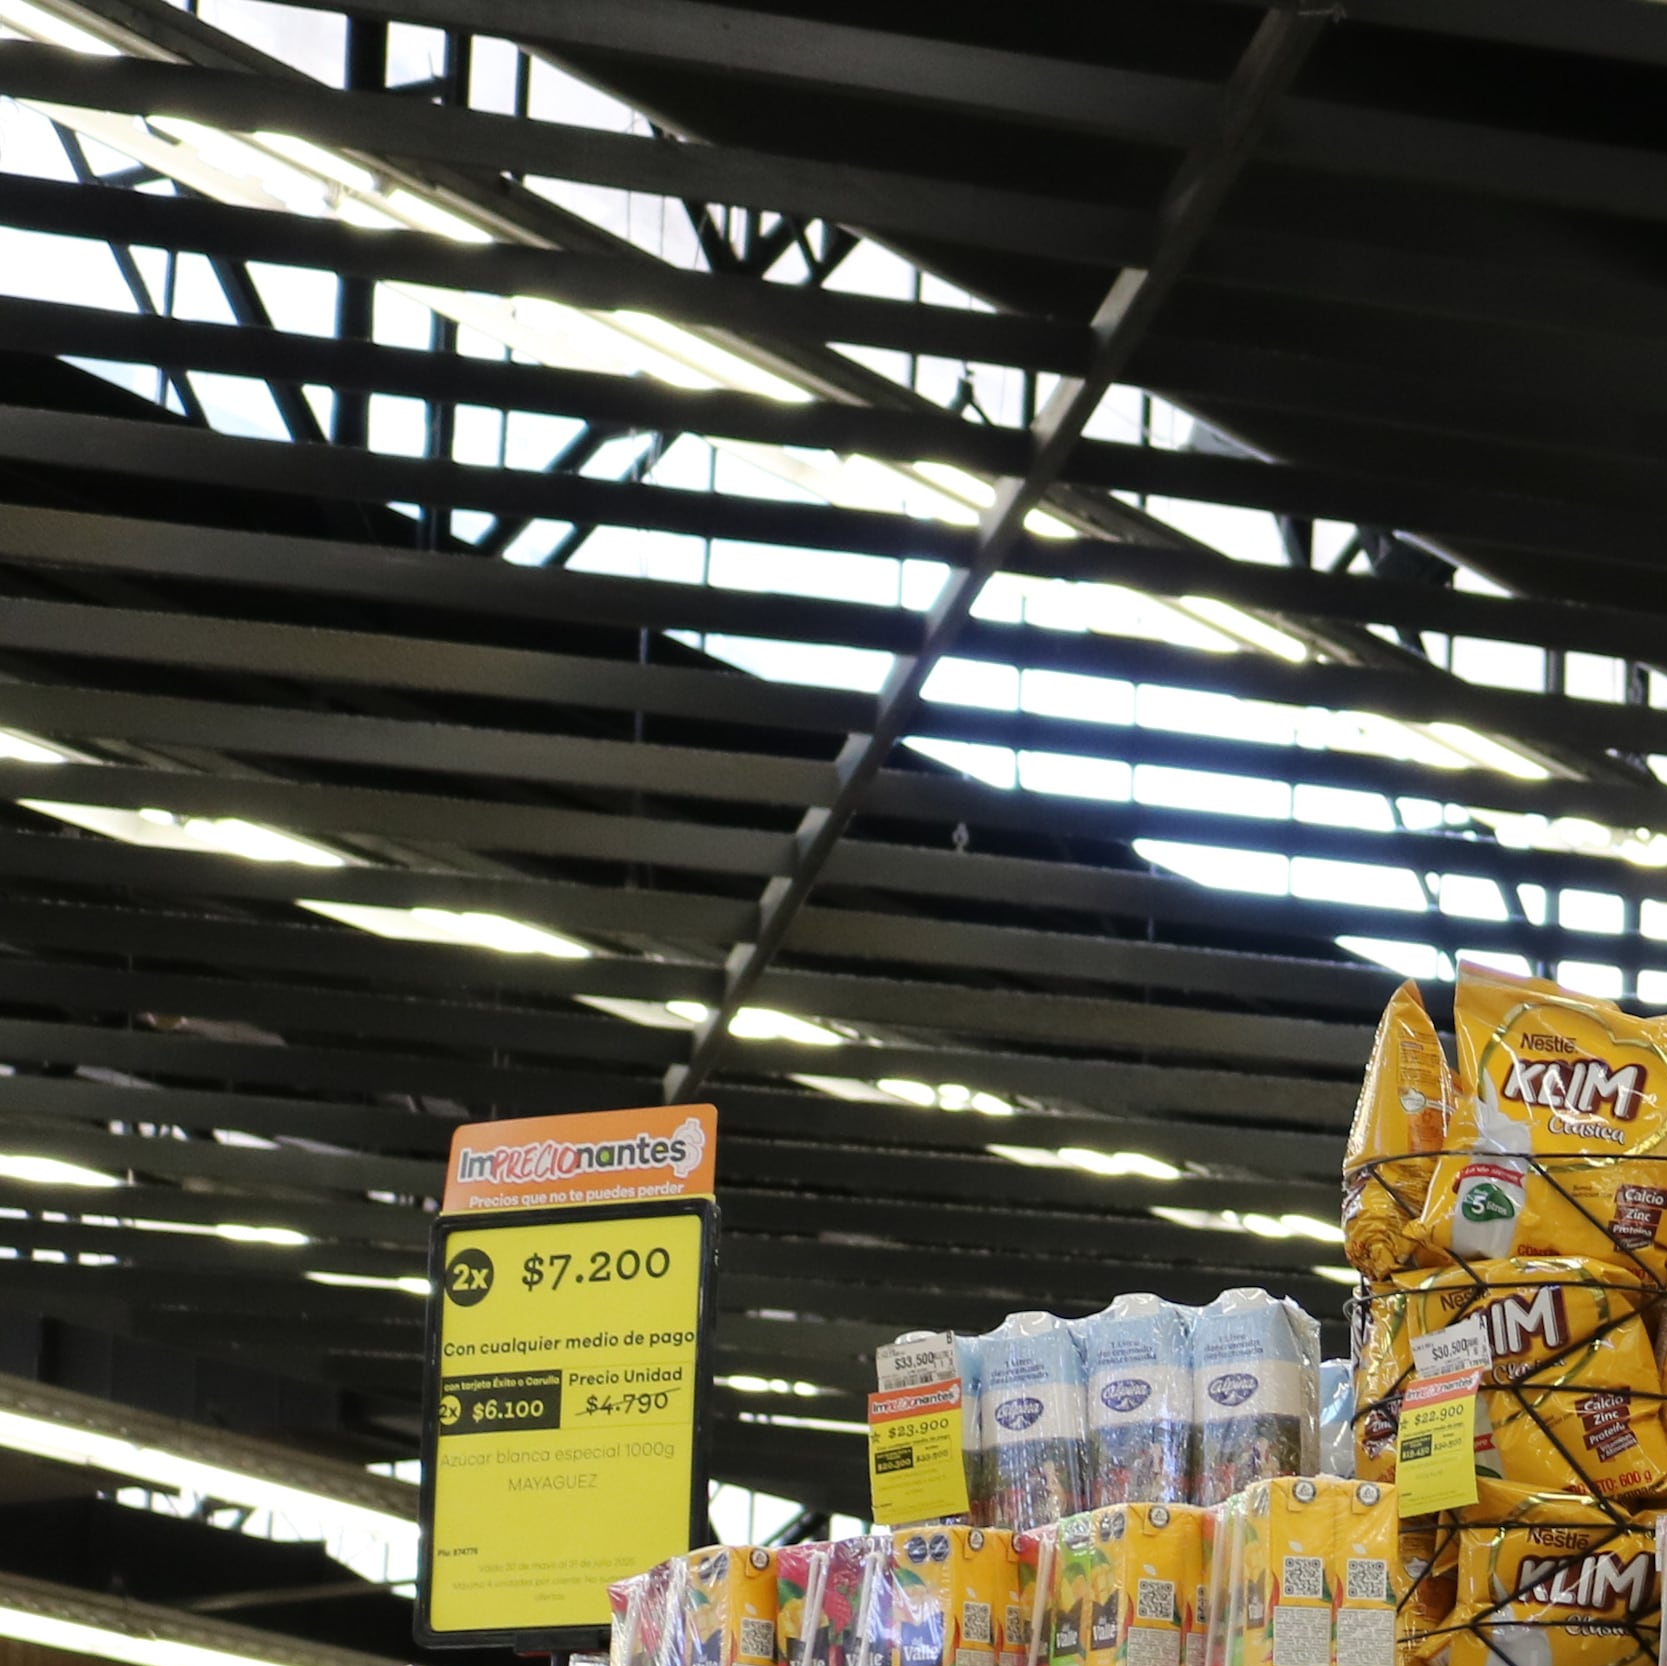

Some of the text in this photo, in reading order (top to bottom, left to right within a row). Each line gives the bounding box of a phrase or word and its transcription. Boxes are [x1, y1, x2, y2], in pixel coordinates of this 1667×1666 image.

[1502, 1058, 1646, 1121] KLIM
[1625, 1189, 1664, 1204] Calcio
[1626, 1209, 1651, 1221] Zinc
[452, 1247, 670, 1292] 2x $7.200
[444, 1330, 694, 1357] Con cualquier medio de pago
[1432, 1339, 1467, 1361] $30,500
[894, 1352, 934, 1370] $33,500
[569, 1368, 682, 1386] Precio Unidad
[472, 1392, 668, 1423] $6.100 $4.790
[1414, 1404, 1464, 1426] $22.900
[888, 1418, 949, 1439] $23.900
[497, 1449, 549, 1464] blanca
[555, 1443, 620, 1462] especial
[626, 1442, 674, 1458] 1000g
[508, 1474, 598, 1492] MAYAGUEZ
